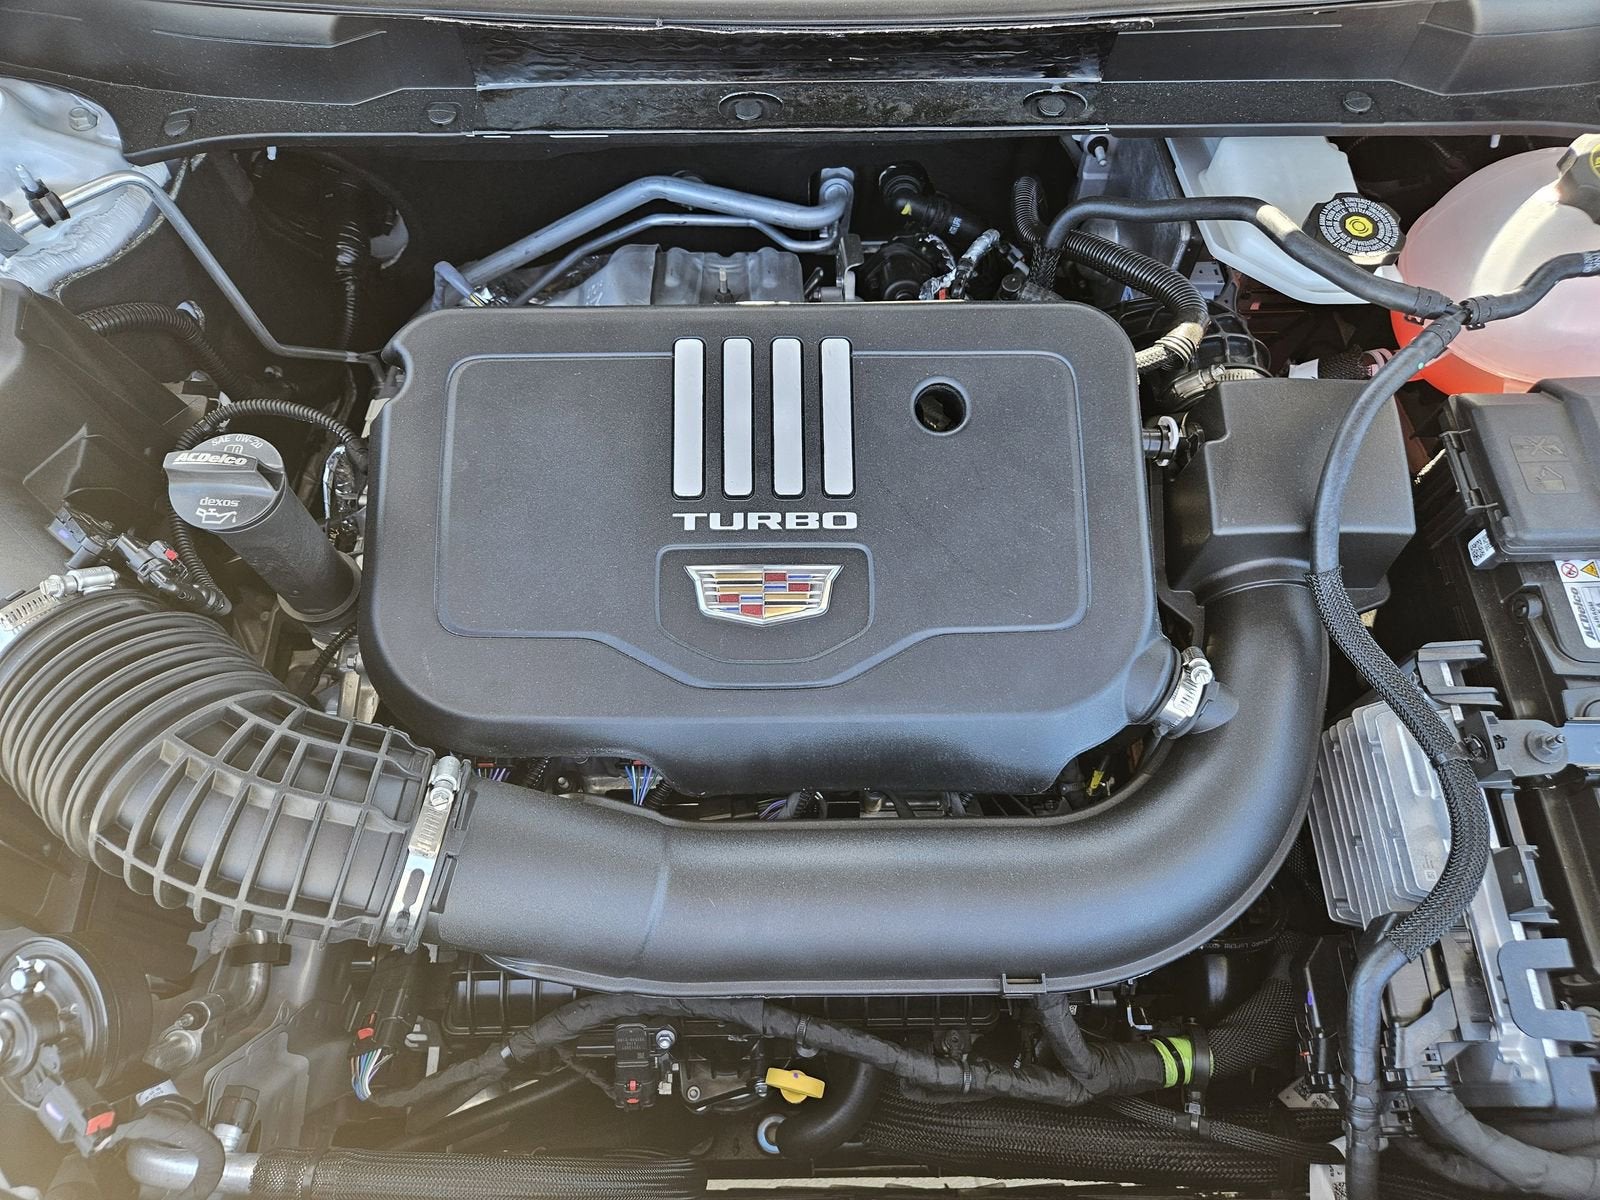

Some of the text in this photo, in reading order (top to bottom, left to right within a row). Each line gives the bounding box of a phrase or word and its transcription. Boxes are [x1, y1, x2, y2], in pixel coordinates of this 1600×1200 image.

[212, 434, 264, 449] SAE 0W-20
[173, 453, 248, 466] ACDelco
[199, 497, 240, 507] dexos
[672, 511, 858, 530] TURBO
[1571, 586, 1597, 641] ACDelco
